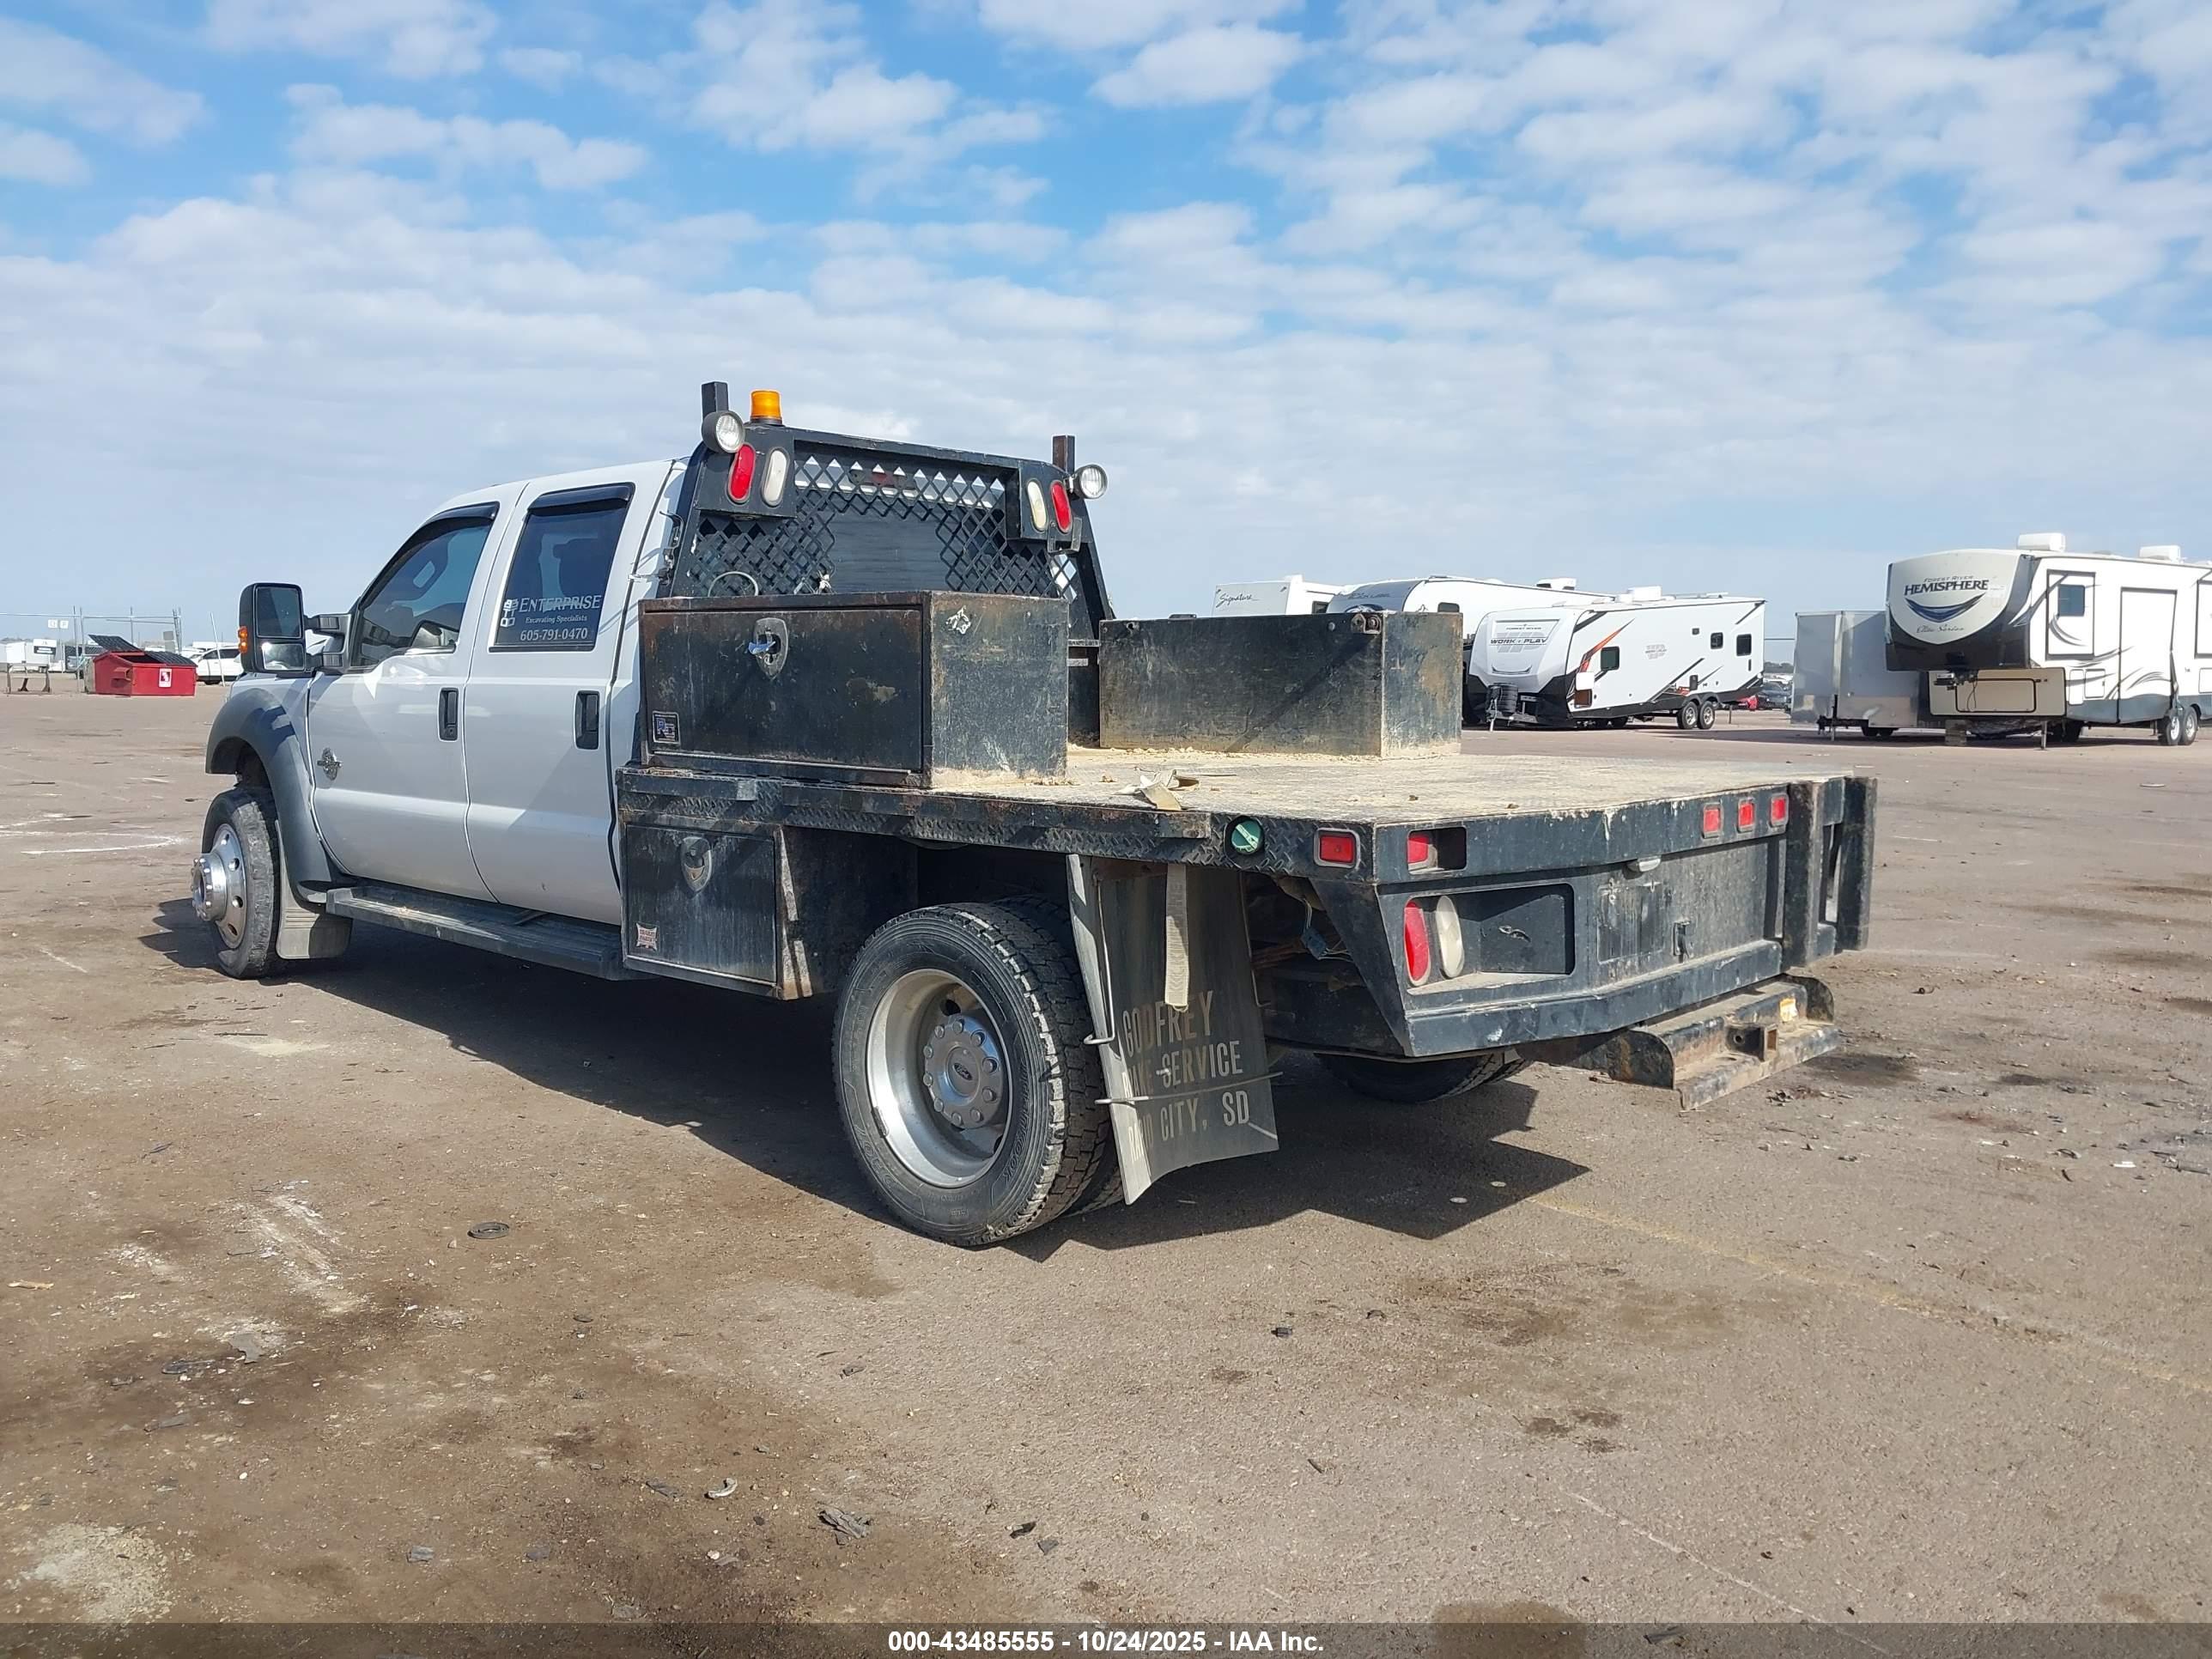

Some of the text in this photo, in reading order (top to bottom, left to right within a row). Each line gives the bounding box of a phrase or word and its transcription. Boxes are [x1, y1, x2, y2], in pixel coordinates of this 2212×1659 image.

[1905, 580, 1989, 595] HEMISPHERE
[520, 595, 602, 612] ENTERPRISE
[1216, 592, 1255, 609] Signature
[556, 615, 587, 623] Specialists
[520, 628, 588, 641] 605-791-0470
[1122, 990, 1214, 1057] GODFREY
[1162, 1041, 1243, 1088] SERVICE
[1222, 1091, 1249, 1127] SD
